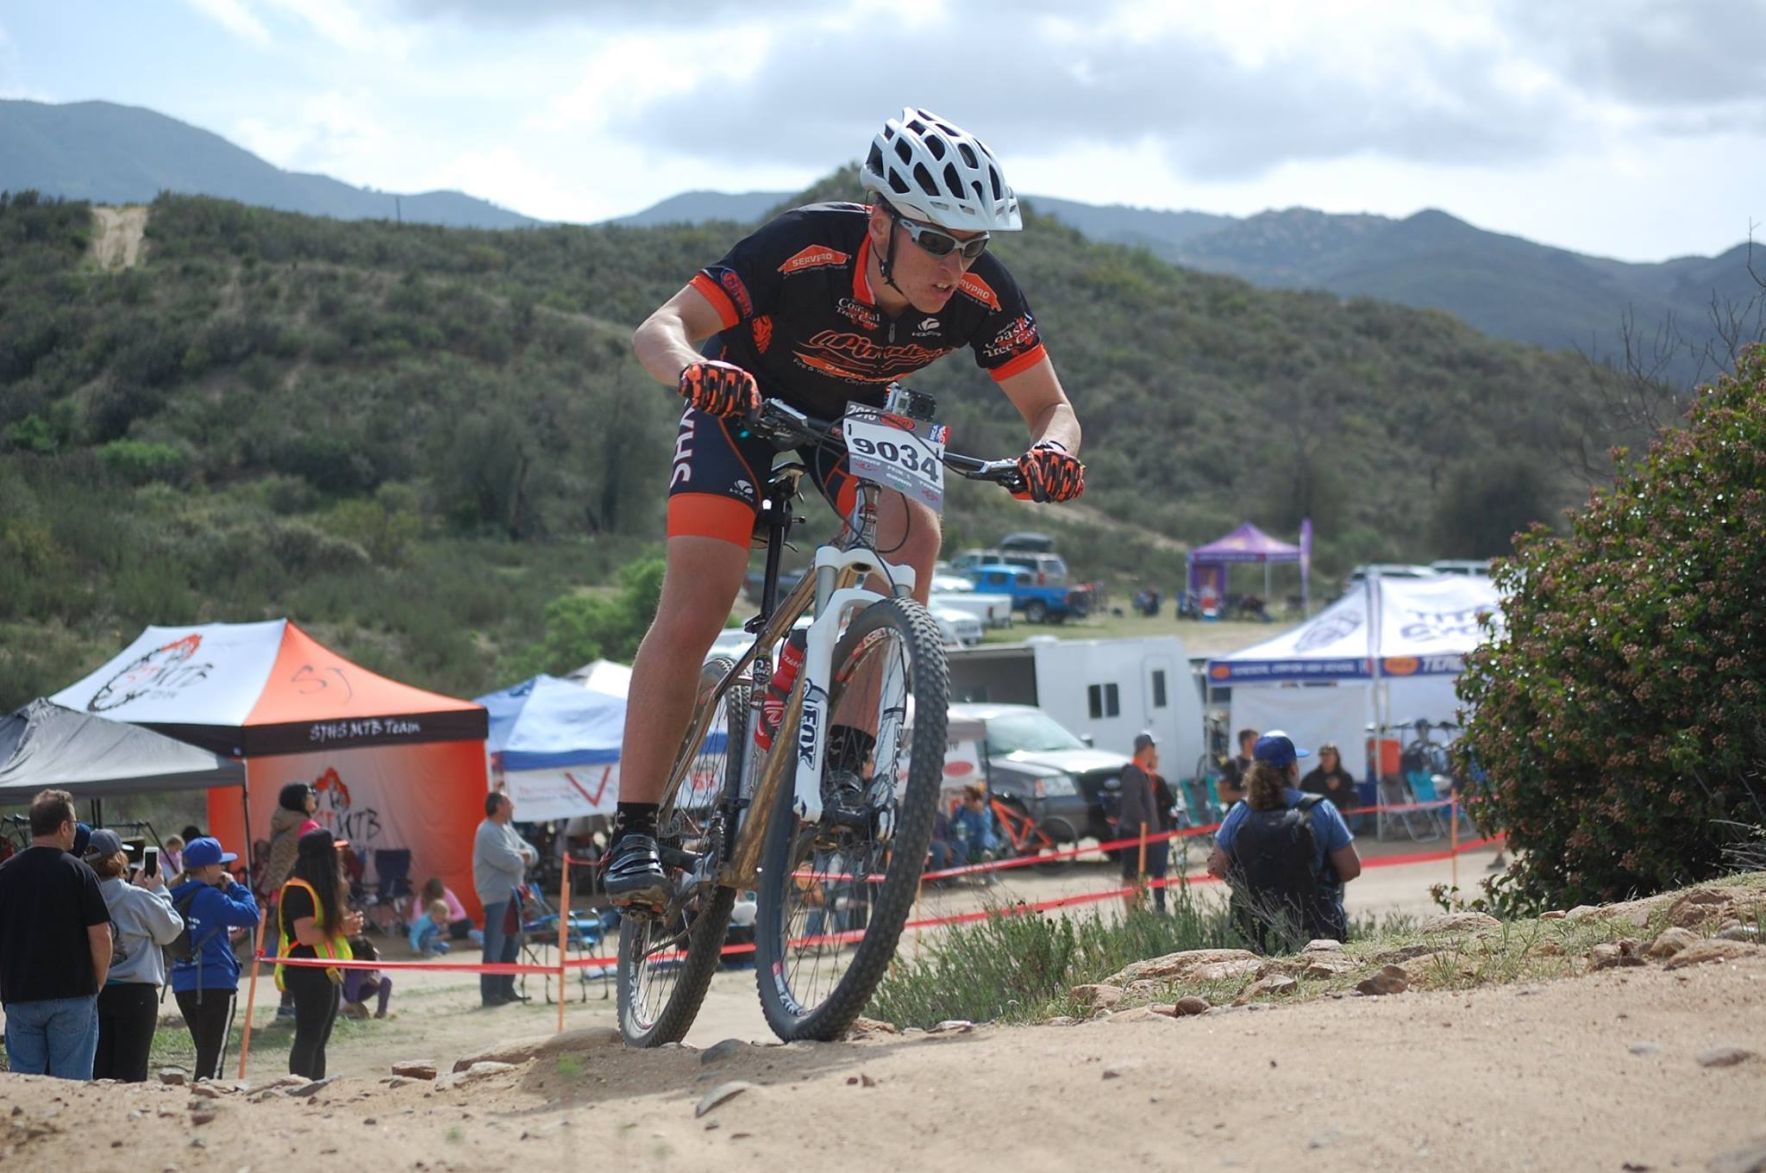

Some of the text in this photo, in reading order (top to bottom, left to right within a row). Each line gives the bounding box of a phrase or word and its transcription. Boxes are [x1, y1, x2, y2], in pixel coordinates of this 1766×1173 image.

[792, 252, 833, 267] SERVPRO
[960, 278, 991, 300] RVPRO
[852, 437, 939, 483] 9034
[349, 719, 382, 738] MTB
[799, 707, 818, 766] FOX
